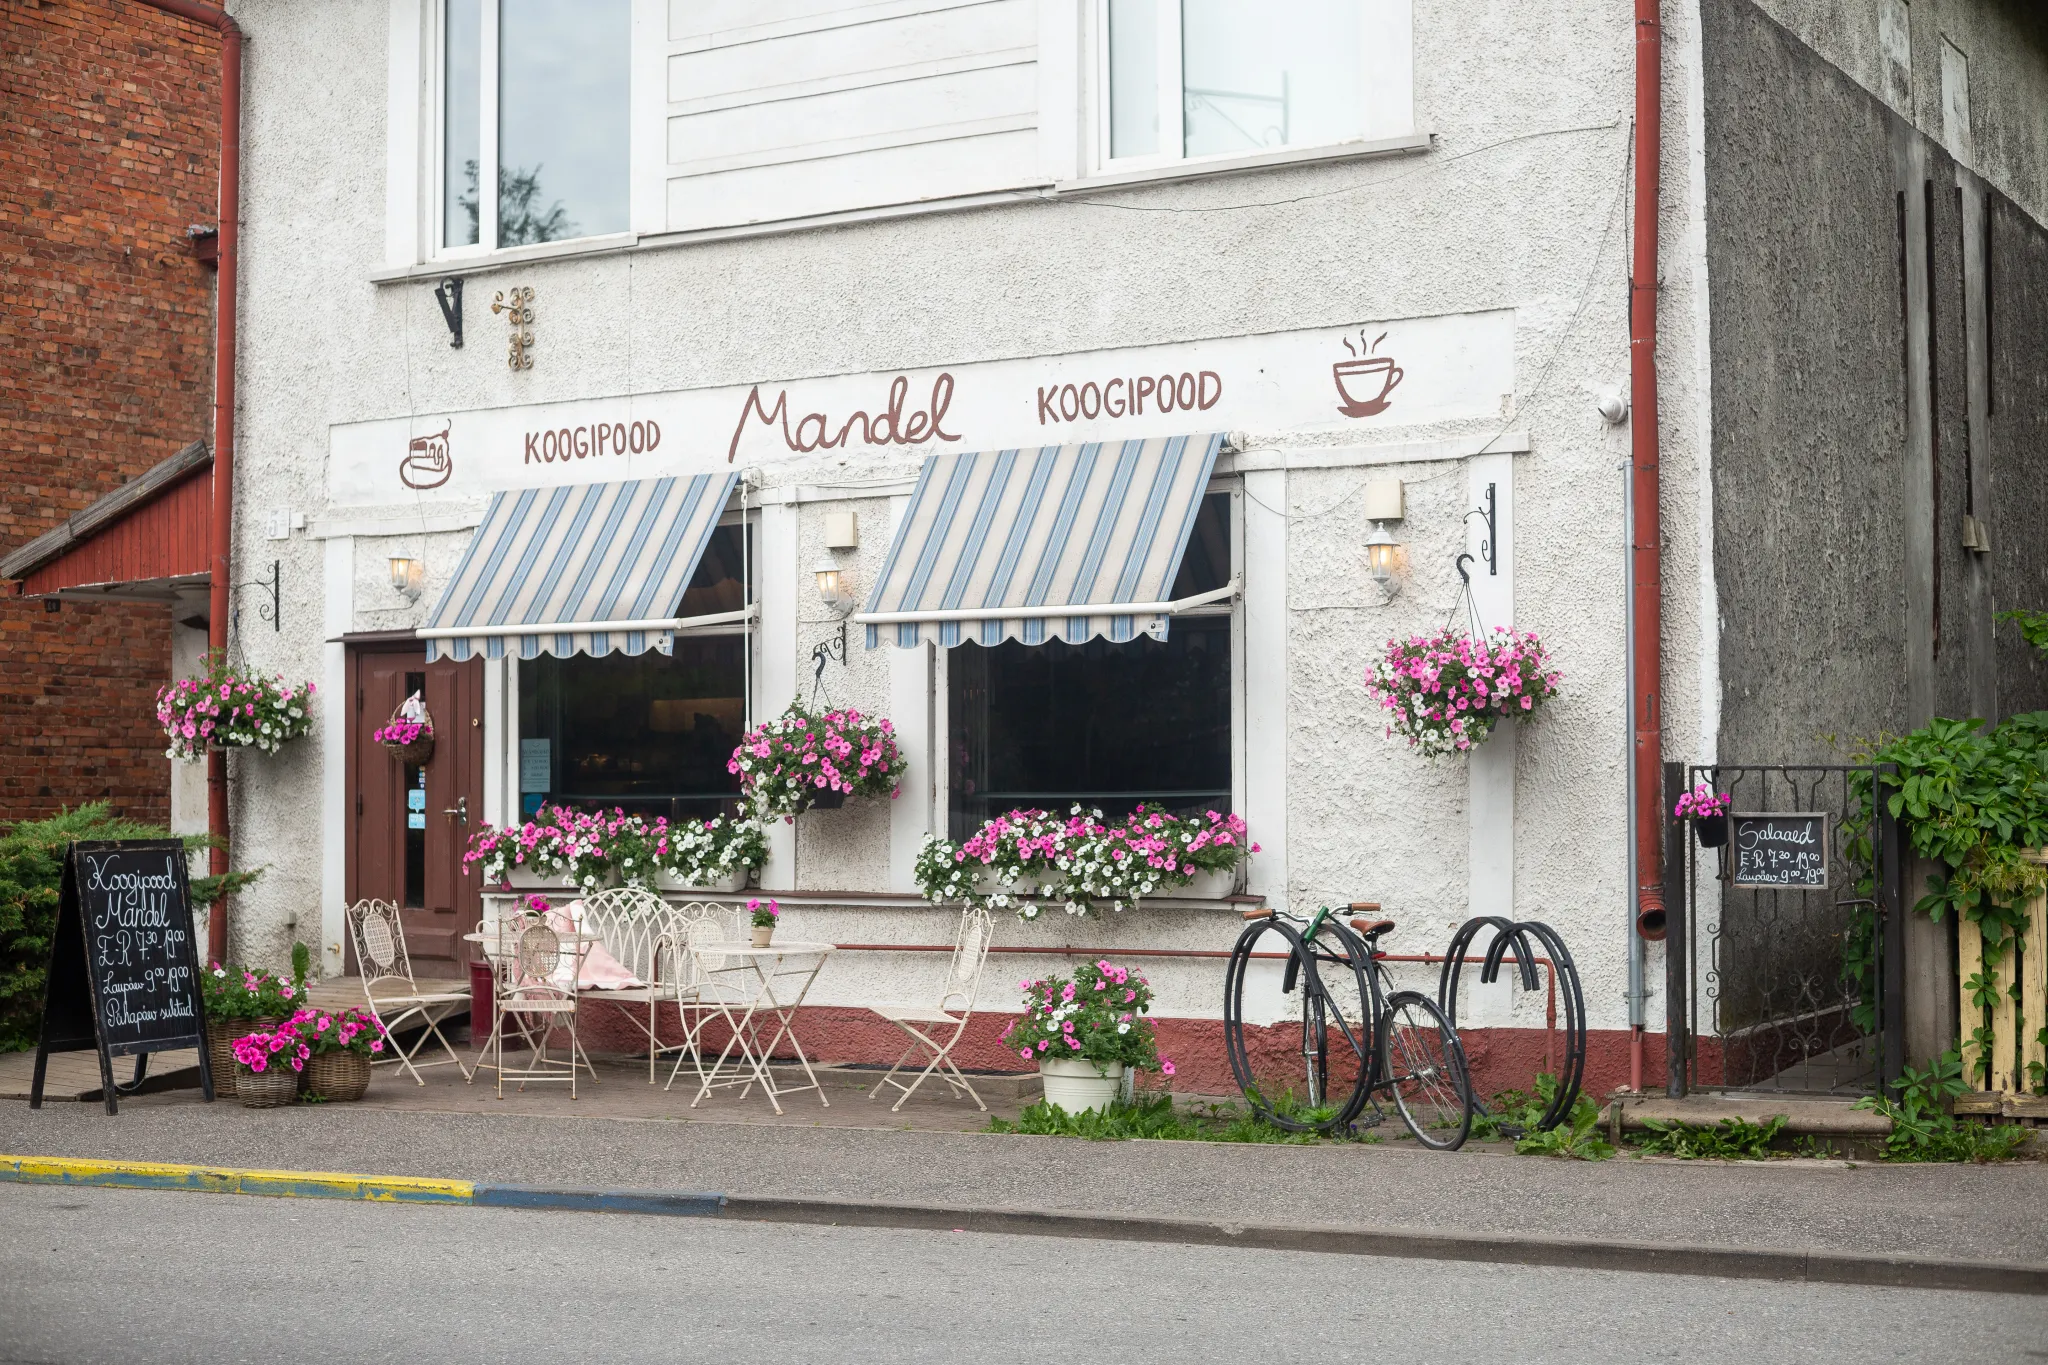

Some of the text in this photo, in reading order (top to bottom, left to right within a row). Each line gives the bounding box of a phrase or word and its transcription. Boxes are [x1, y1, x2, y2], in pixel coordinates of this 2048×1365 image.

[727, 372, 962, 464] Mandel
[1037, 370, 1222, 425] KOOGIPOOD
[524, 419, 661, 465] KOOGIPOOD
[1739, 821, 1815, 850] Salaaed
[87, 854, 177, 911] Koogipood
[1736, 868, 1778, 884] Laupäev
[95, 892, 170, 929] Mandel
[160, 993, 194, 1020] suletud
